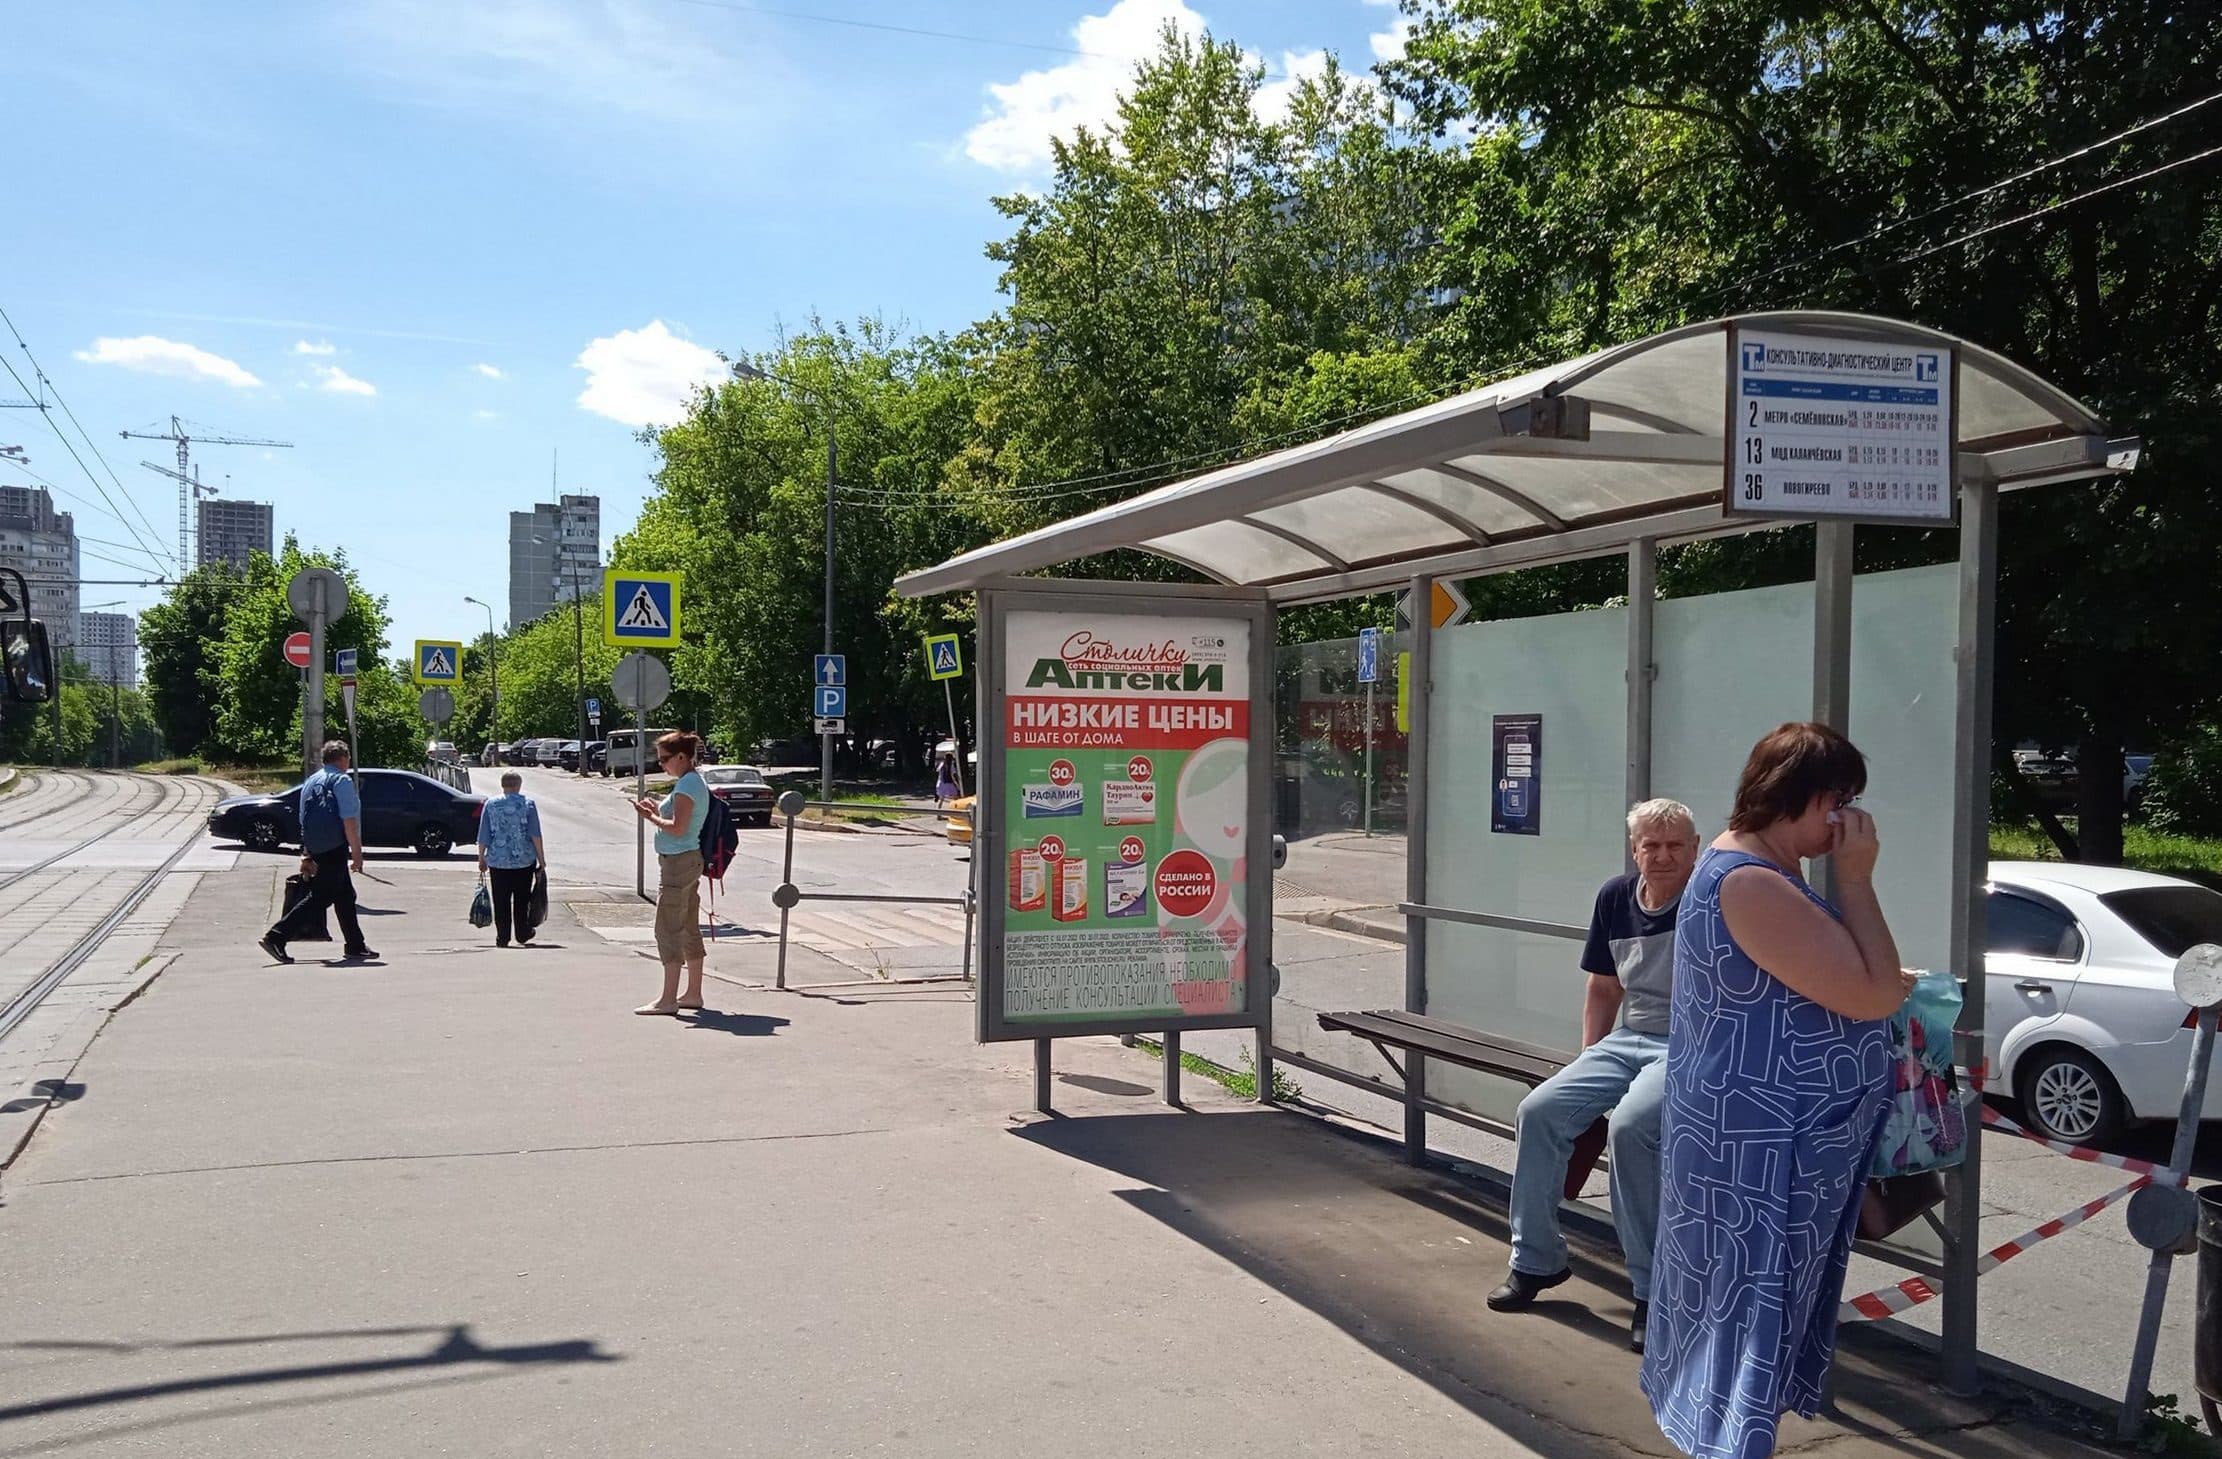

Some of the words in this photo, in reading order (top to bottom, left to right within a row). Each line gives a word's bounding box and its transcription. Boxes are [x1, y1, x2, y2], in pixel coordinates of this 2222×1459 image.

[1891, 356, 1912, 372] ЦЕНТР
[1749, 401, 1758, 428] 2
[1765, 411, 1789, 424] МЕТРО
[1745, 437, 1762, 464] 13
[1745, 474, 1763, 501] 36
[1059, 631, 1191, 663] Столички
[1068, 662, 1088, 671] сеть
[1091, 663, 1152, 672] социальных
[1154, 664, 1182, 673] аптек
[823, 690, 839, 713] P
[1013, 703, 1139, 729] НИЗКИЕ
[1148, 706, 1233, 733] ЦЕНЫ
[1014, 733, 1021, 744] В
[1024, 733, 1059, 745] ШАГЕ
[1063, 733, 1079, 745] ОТ
[1082, 734, 1123, 746] ДОМА
[1030, 790, 1080, 801] РАФАМИН
[1160, 873, 1201, 883] СДЕЛАНО
[1204, 872, 1211, 881] В
[1159, 886, 1212, 897] РОССИИ
[1006, 966, 1057, 989] ИМЕЮТСЯ
[1170, 959, 1235, 982] НЕОБХОДИМО
[1006, 988, 1070, 1012] ПОЛУЧЕНИЕ
[1076, 984, 1158, 1008] КОНСУЛЬТАЦИИ
[1164, 981, 1236, 1006] СПЕЦИАЛИСТА
